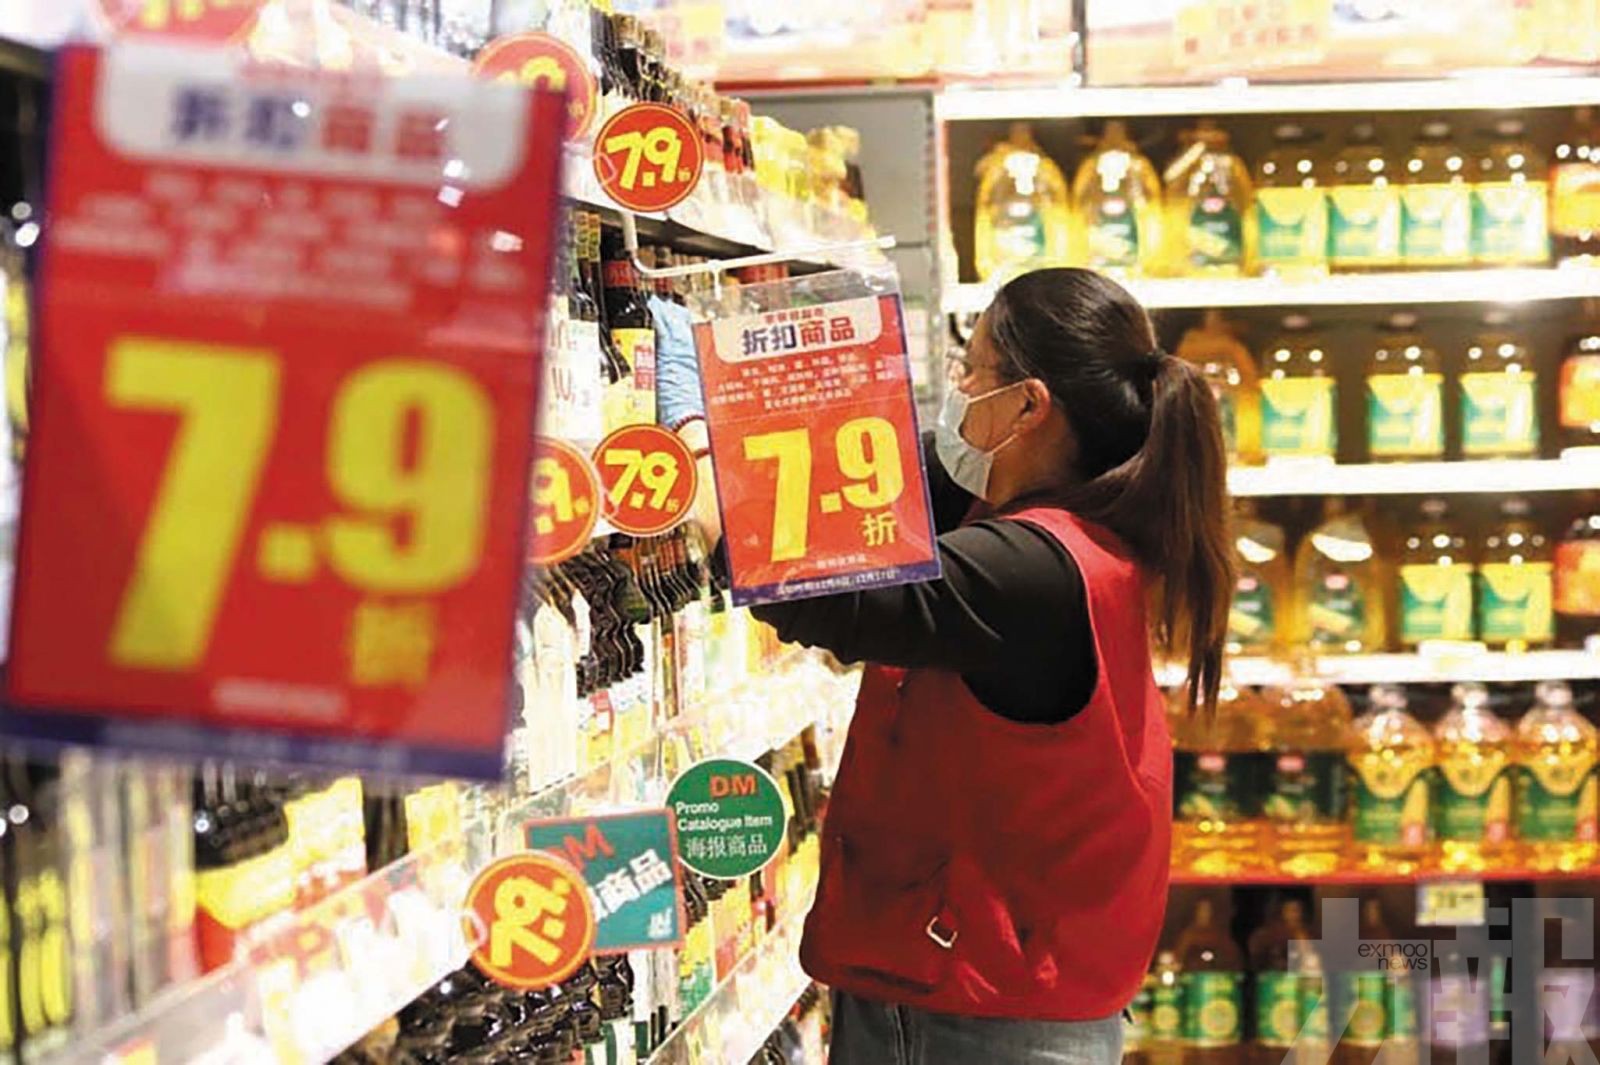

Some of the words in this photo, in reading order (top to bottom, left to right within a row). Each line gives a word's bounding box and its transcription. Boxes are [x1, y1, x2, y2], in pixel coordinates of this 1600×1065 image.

[741, 316, 855, 355] 折扣商品
[107, 336, 495, 671] 7.9
[743, 416, 904, 563] 7.9
[861, 511, 898, 547] 折
[711, 775, 757, 797] DM
[676, 801, 720, 815] Promo
[678, 816, 743, 832] Catalogue
[686, 832, 769, 859] 海报商品
